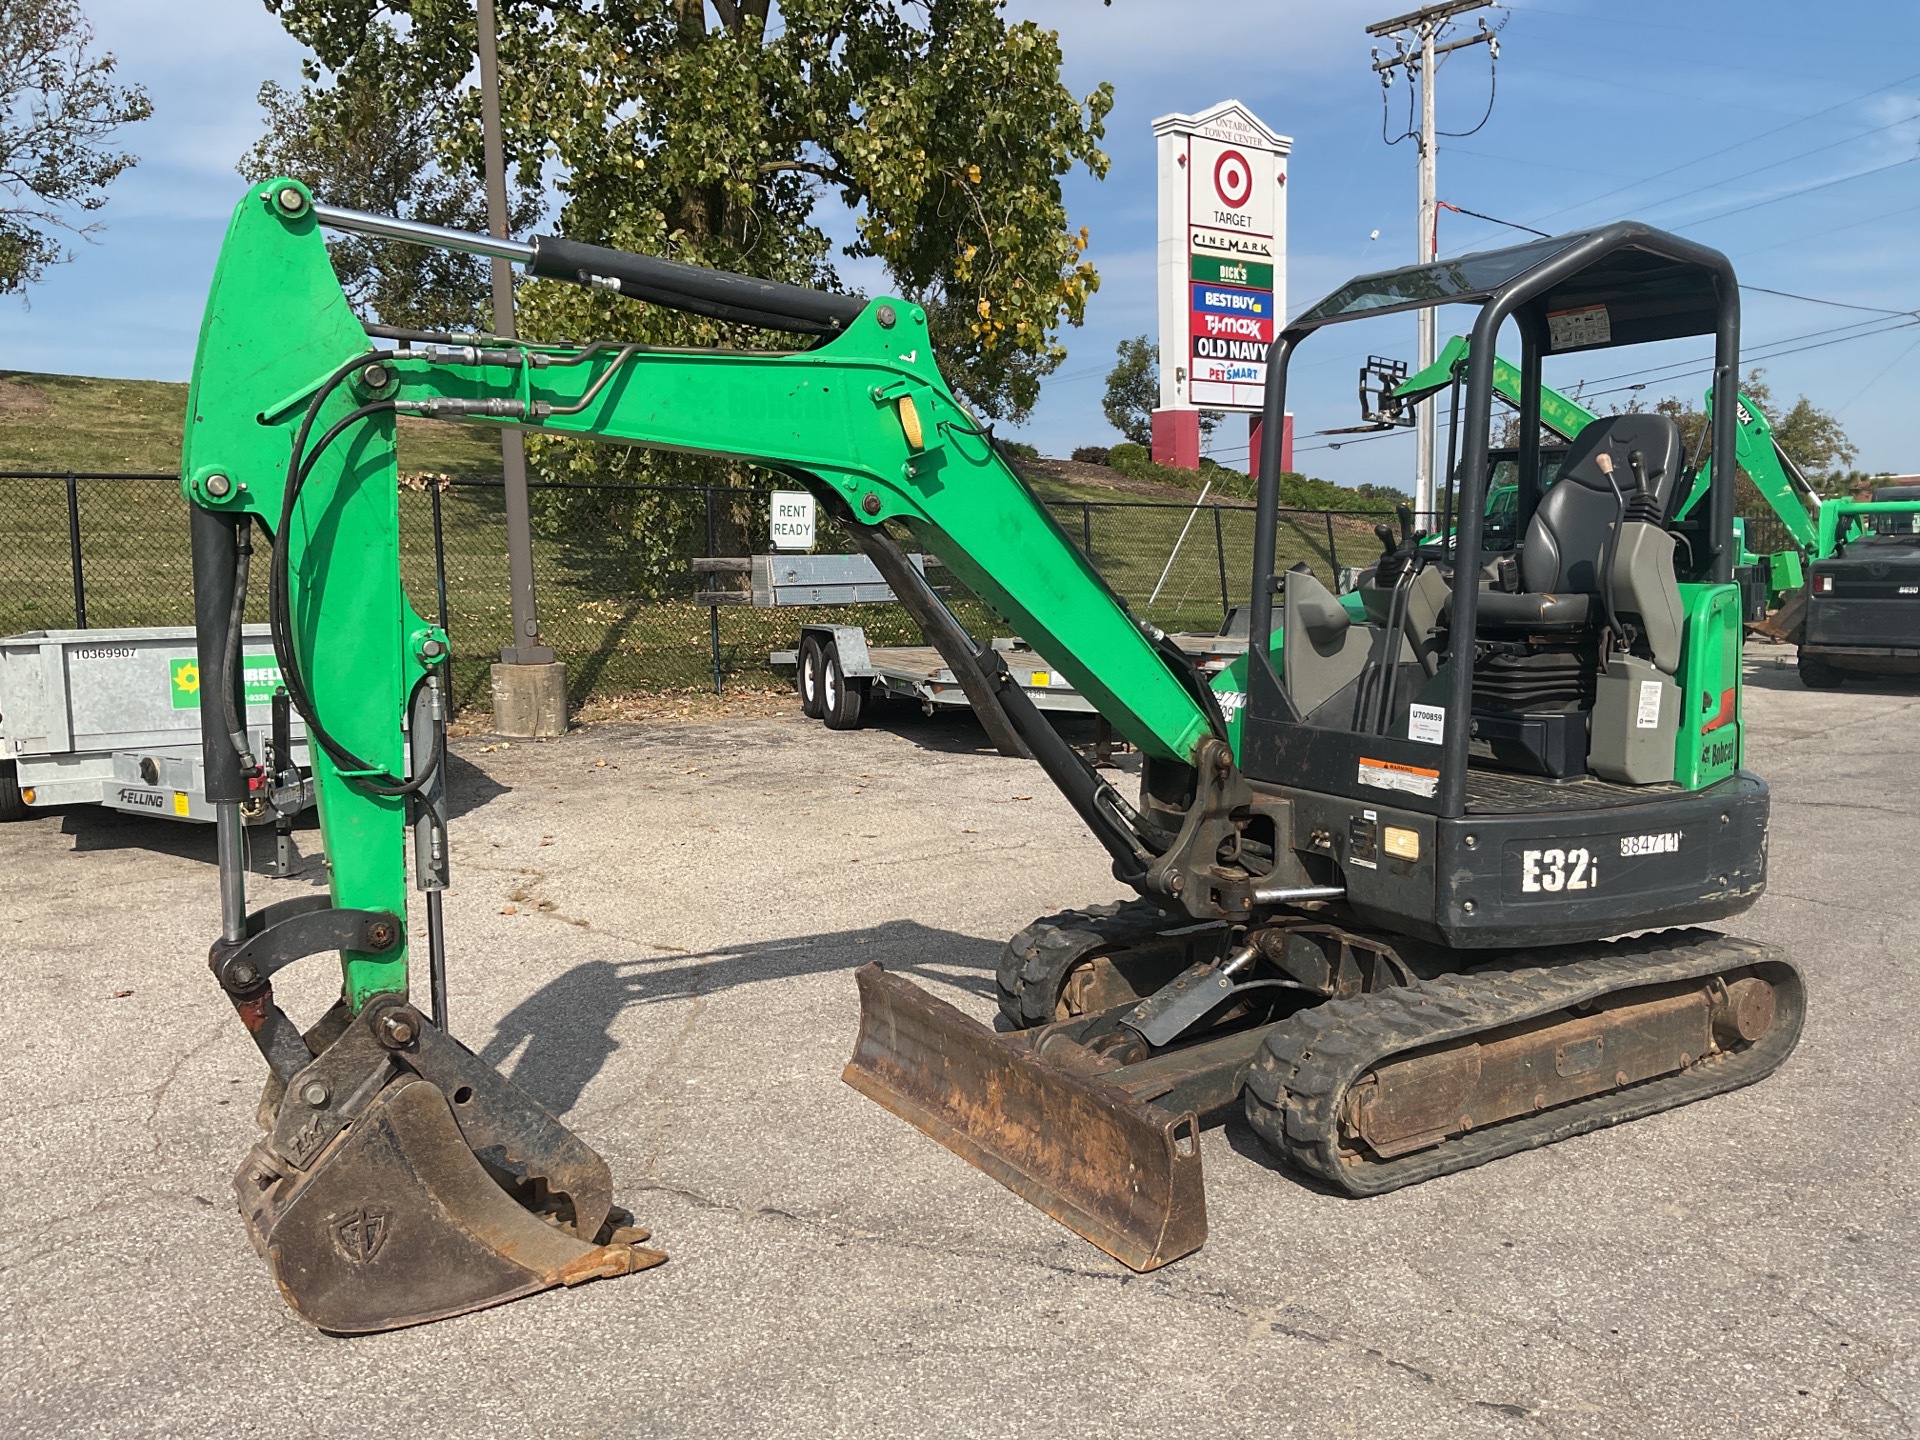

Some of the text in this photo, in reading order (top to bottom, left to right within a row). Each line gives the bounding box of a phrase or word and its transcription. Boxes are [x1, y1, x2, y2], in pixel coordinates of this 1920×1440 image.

[1215, 118, 1251, 132] ONTARIO
[1204, 126, 1263, 147] TOWNE CENTER
[1213, 211, 1253, 228] TARGET
[1193, 234, 1272, 257] CINEMARK
[1219, 264, 1247, 280] DICK'S
[1205, 292, 1255, 311] BEST BUY
[1198, 338, 1269, 362] OLD NAVY
[779, 505, 806, 517] RENT
[774, 523, 811, 535] READY
[74, 647, 137, 660] 10369907
[1711, 739, 1734, 768] Bobcat
[1389, 764, 1413, 773] WARNING
[117, 788, 164, 808] FELLING
[1620, 833, 1676, 855] 884711
[1522, 848, 1598, 893] E32i
